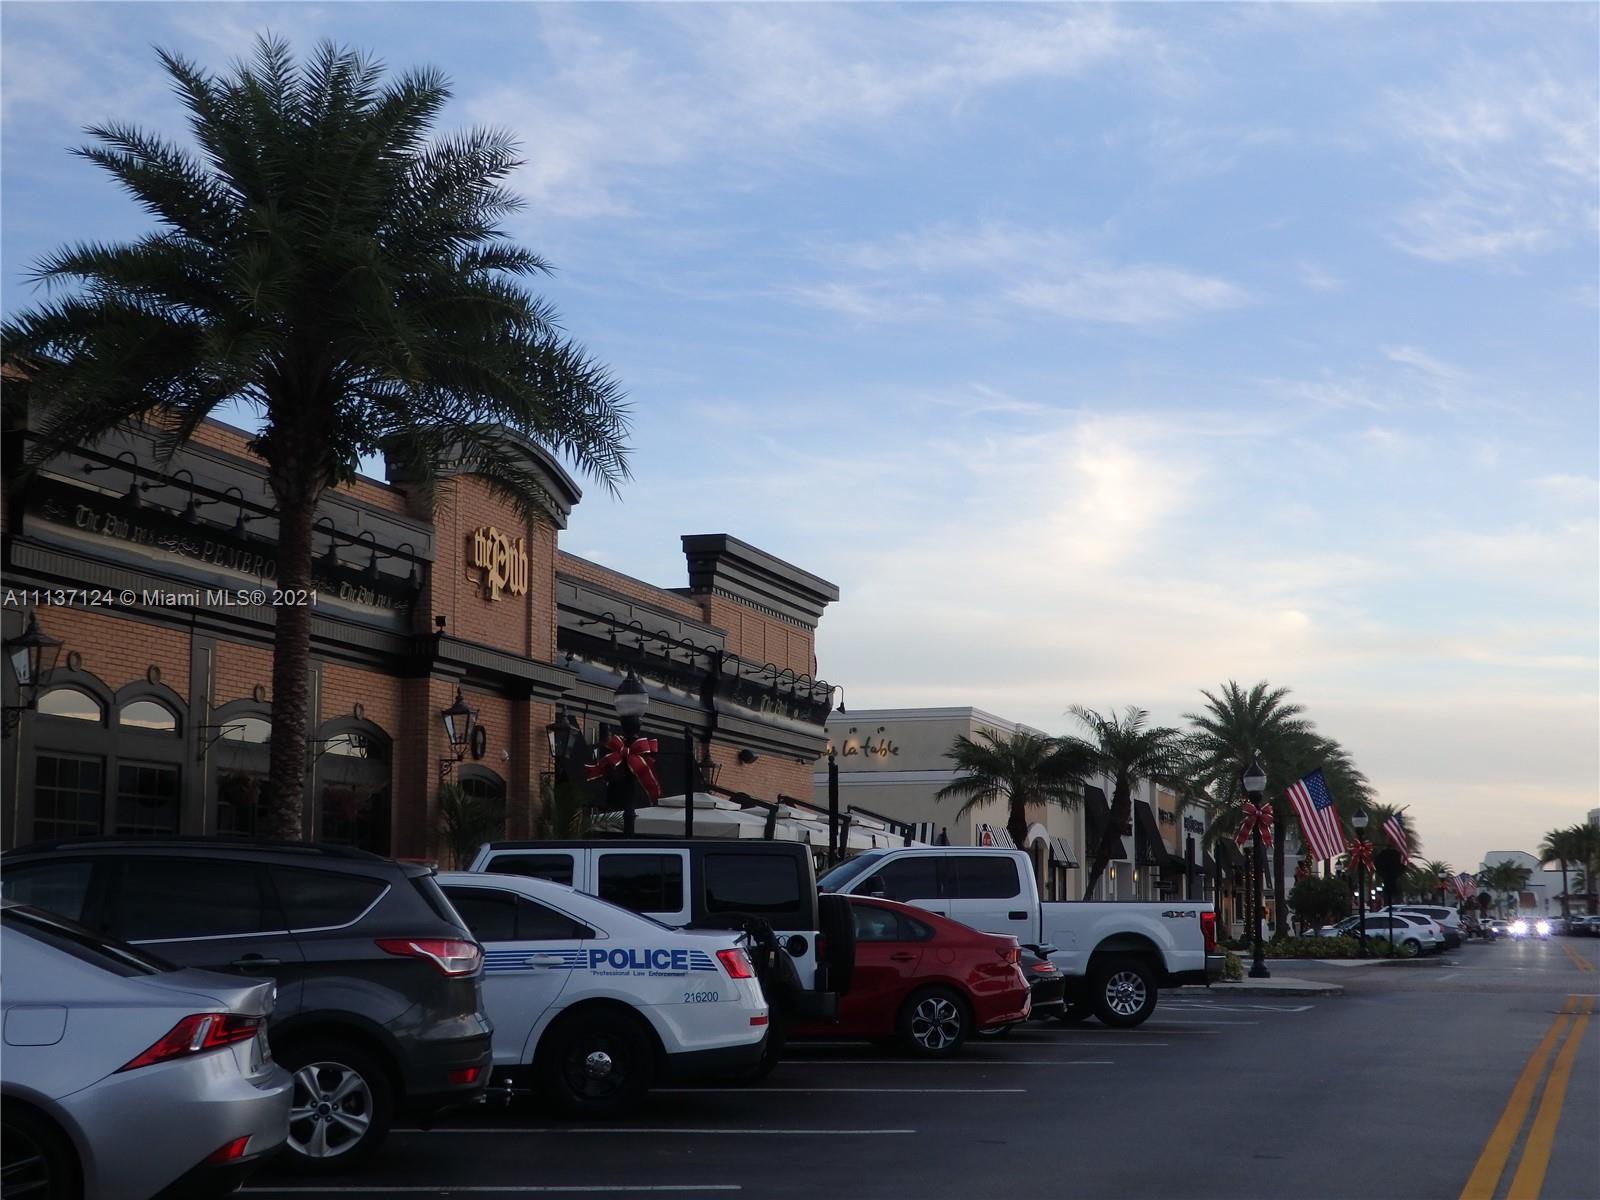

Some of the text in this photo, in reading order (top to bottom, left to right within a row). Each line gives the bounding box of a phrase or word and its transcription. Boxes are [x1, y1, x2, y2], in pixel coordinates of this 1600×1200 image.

[200, 540, 278, 579] PEMBRO
[842, 740, 858, 757] la
[860, 736, 899, 758] table
[589, 949, 688, 970] POLICE
[683, 991, 719, 1004] 216200
